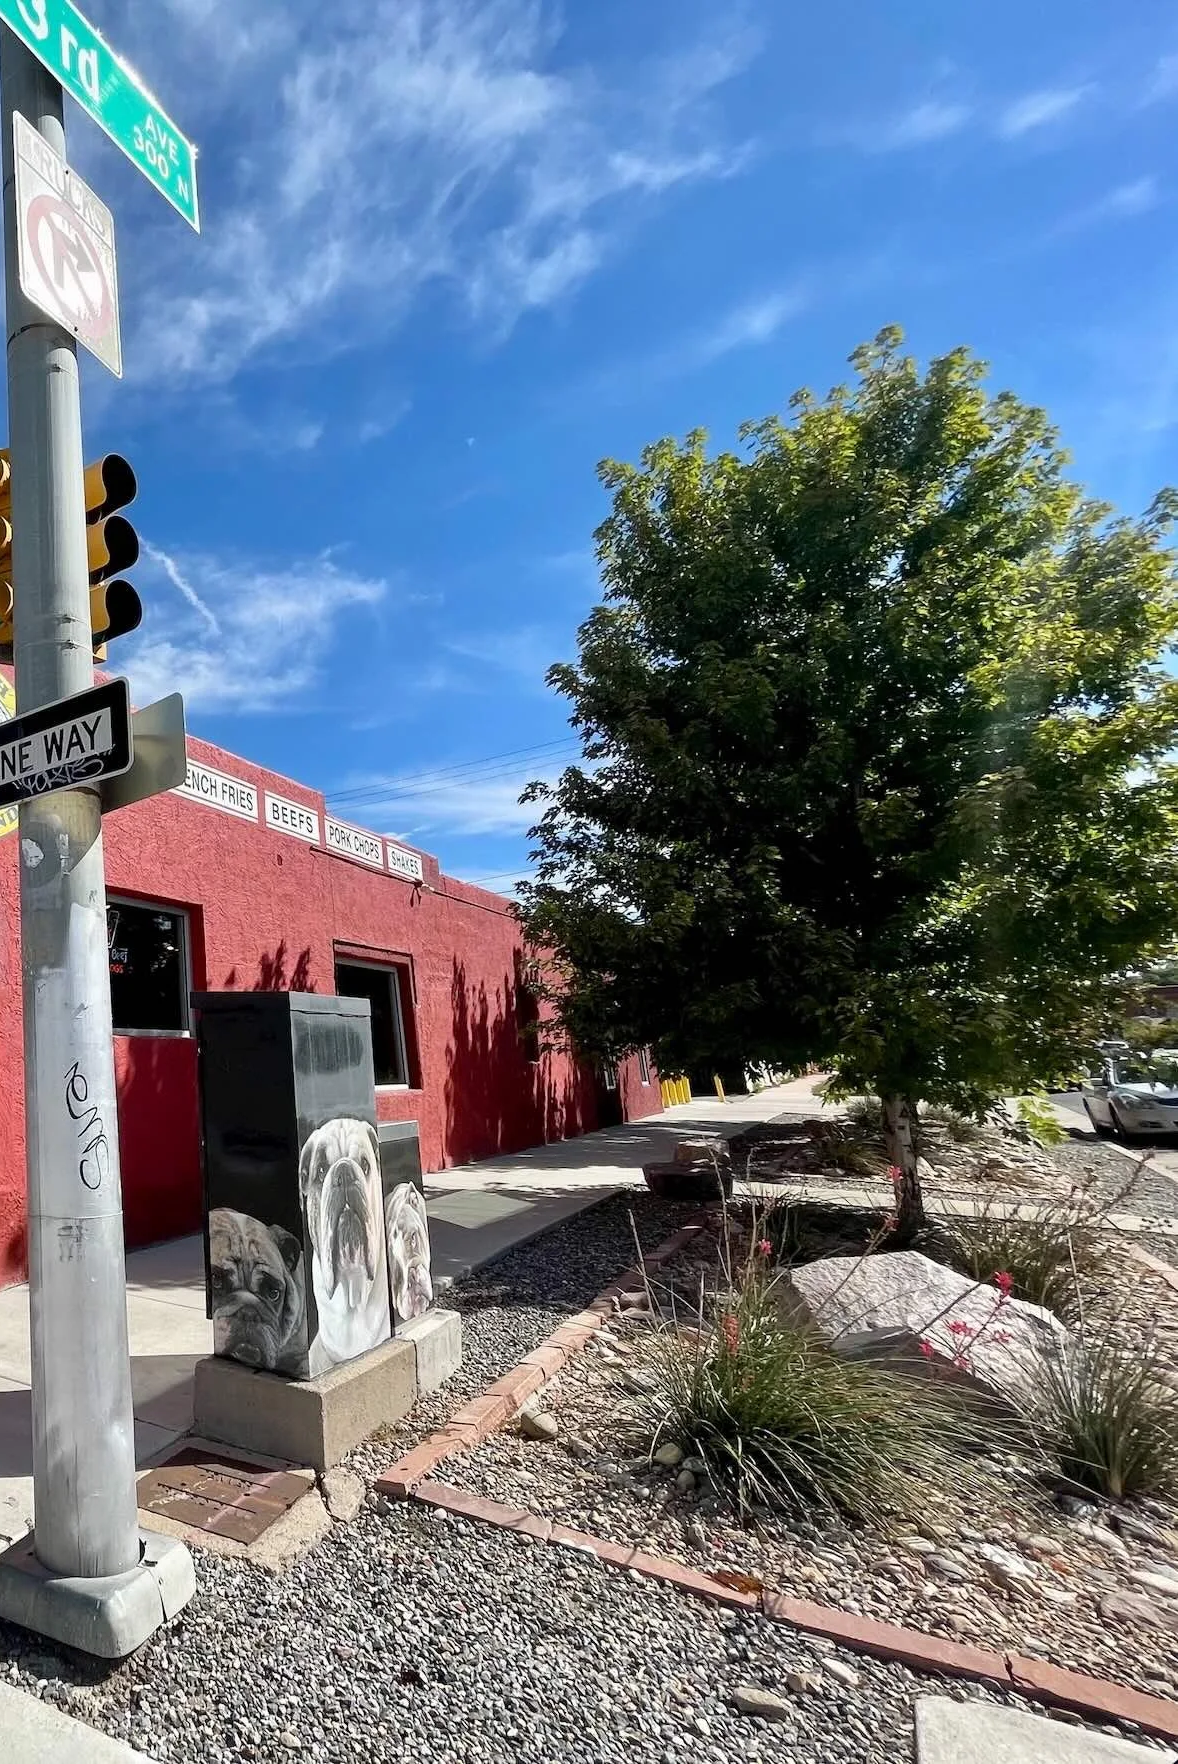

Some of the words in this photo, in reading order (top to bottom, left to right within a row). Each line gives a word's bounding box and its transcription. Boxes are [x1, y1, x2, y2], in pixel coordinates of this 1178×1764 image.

[145, 114, 179, 166] AVE
[133, 125, 169, 178] 300
[177, 174, 189, 204] N
[43, 715, 102, 765] WAY
[221, 782, 254, 812] FRIES
[272, 802, 314, 834] BEEFS
[329, 824, 352, 848] PORK
[354, 832, 380, 860] CHOPS
[391, 852, 419, 875] SHAKES
